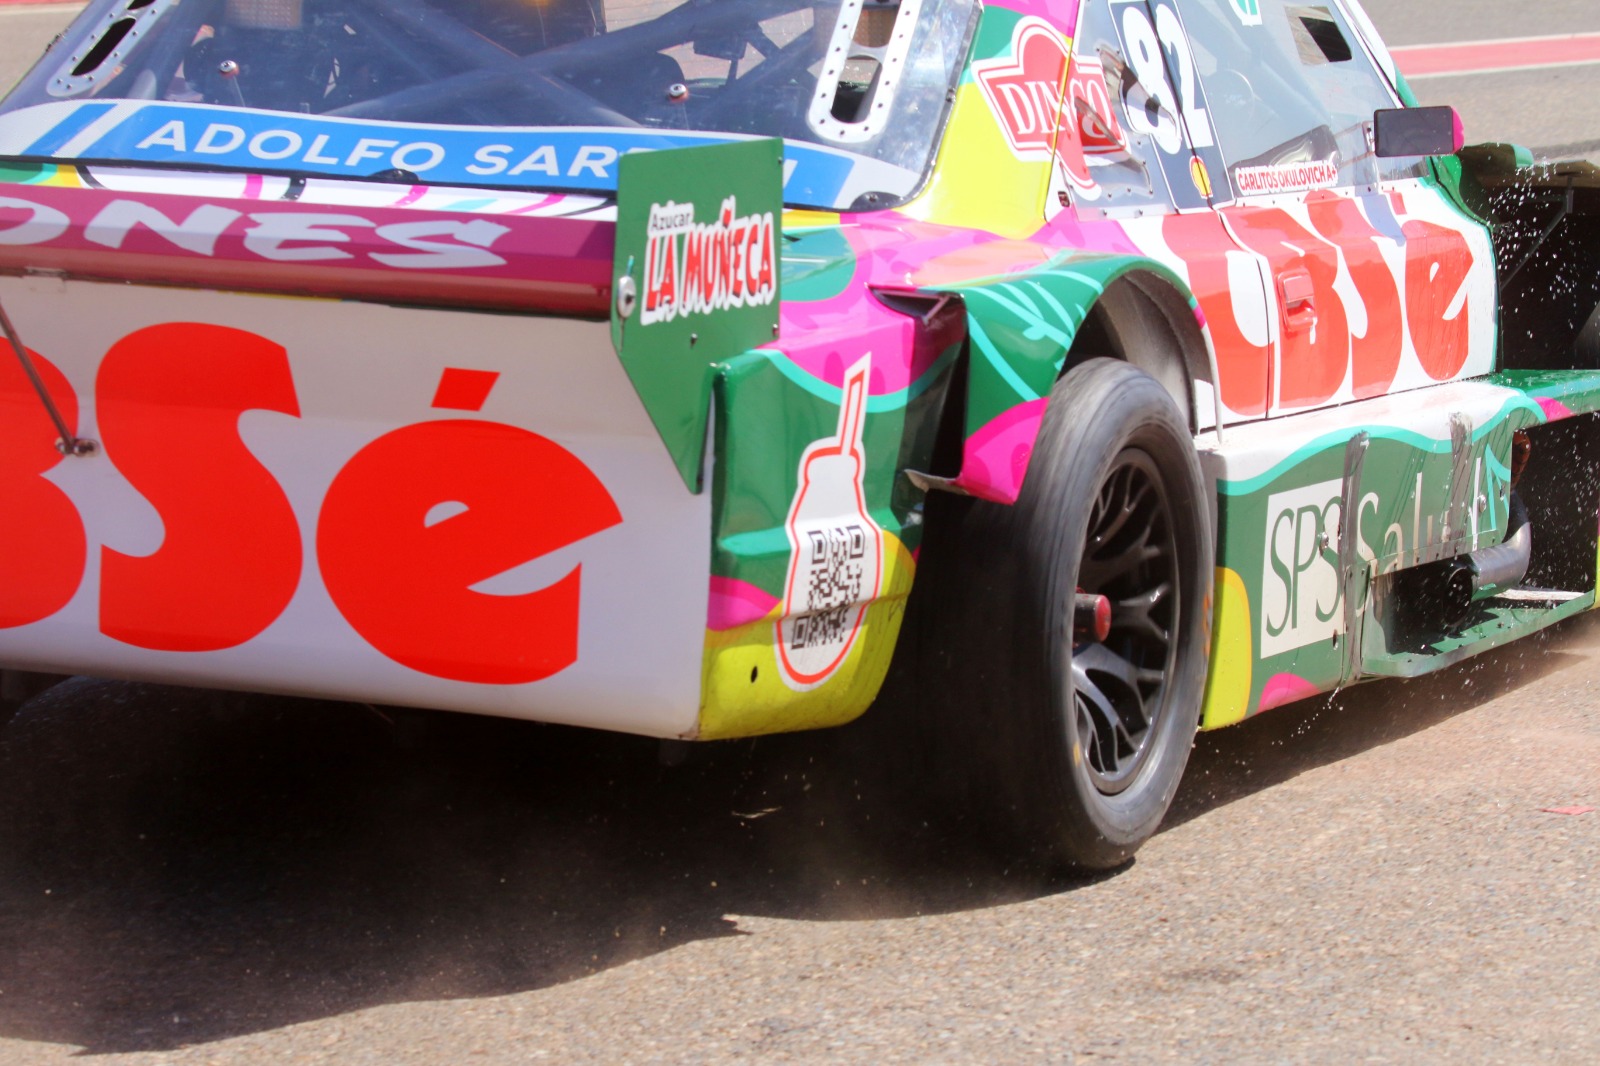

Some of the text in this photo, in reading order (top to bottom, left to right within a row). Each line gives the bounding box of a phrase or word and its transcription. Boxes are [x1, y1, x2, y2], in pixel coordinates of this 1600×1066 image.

[996, 79, 1112, 138] DINGO
[1122, 3, 1214, 155] 82
[137, 119, 798, 190] ADOLFO SARI
[1238, 171, 1278, 191] CARLITOS
[1278, 166, 1325, 188] OKULOVICH
[645, 207, 772, 313] LA MUÑECA
[1266, 496, 1345, 637] SPS
